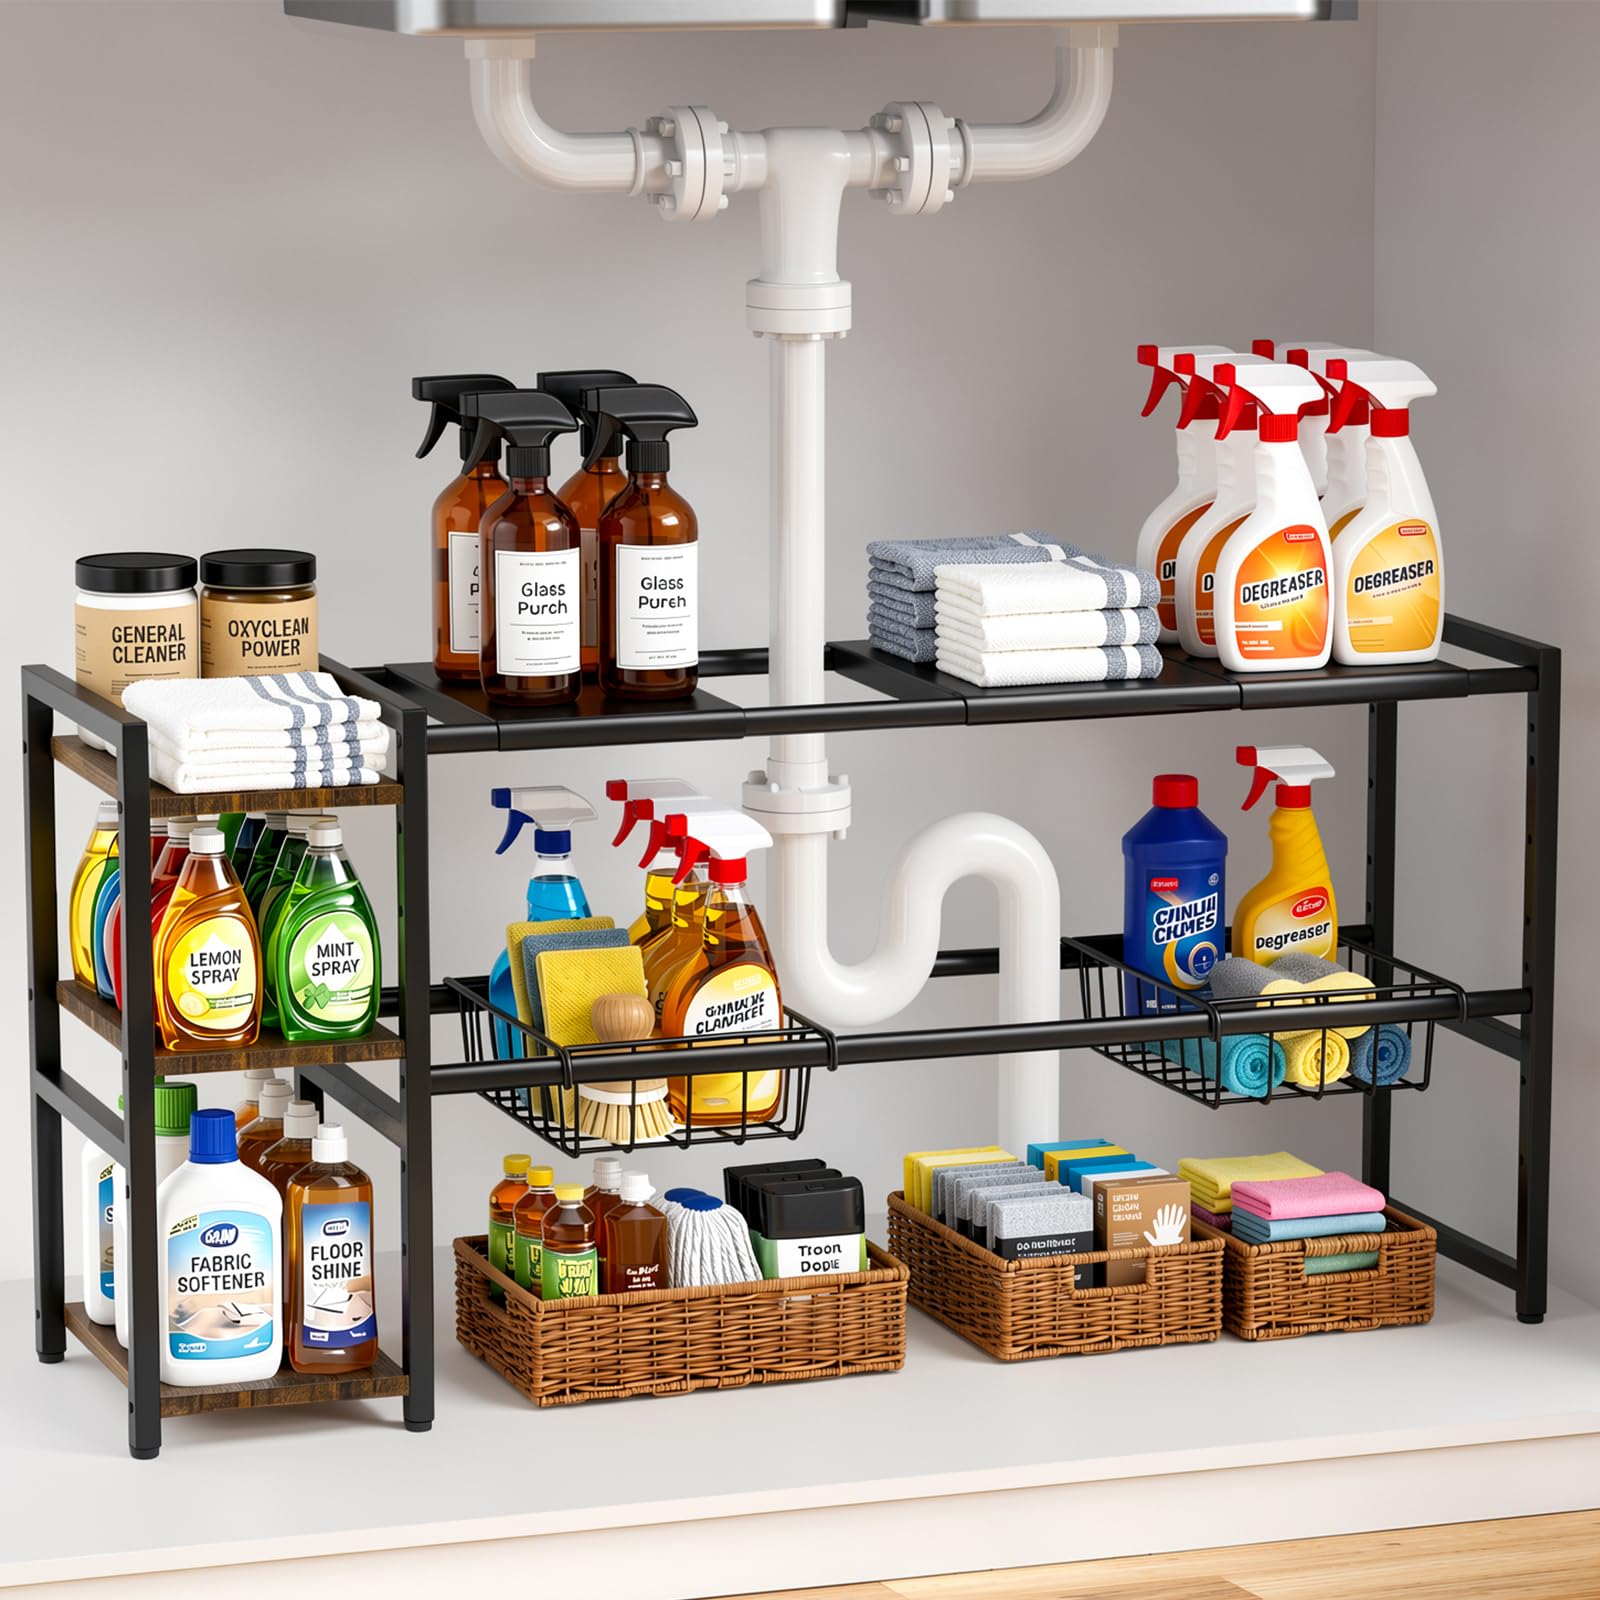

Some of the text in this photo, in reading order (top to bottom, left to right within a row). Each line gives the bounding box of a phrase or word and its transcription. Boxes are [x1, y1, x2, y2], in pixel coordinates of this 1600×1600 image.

[521, 582, 566, 597] Glass
[640, 575, 684, 590] Glass
[1242, 569, 1324, 604] DEGREASER
[518, 599, 568, 615] Purch
[112, 623, 186, 643] GENERAL
[228, 617, 309, 638] OXYCLEAN
[112, 643, 186, 664] CLEANER
[242, 638, 300, 657] POWER
[1256, 922, 1330, 950] Degreaser
[190, 949, 241, 967] LEMON
[317, 941, 355, 959] MINT
[191, 967, 240, 985] SPRAY
[312, 958, 360, 977] SPRAY
[311, 1241, 363, 1261] FLOOR
[191, 1253, 252, 1273] FABRIC
[312, 1261, 362, 1280] SHINE
[178, 1271, 265, 1293] SOFTENER
